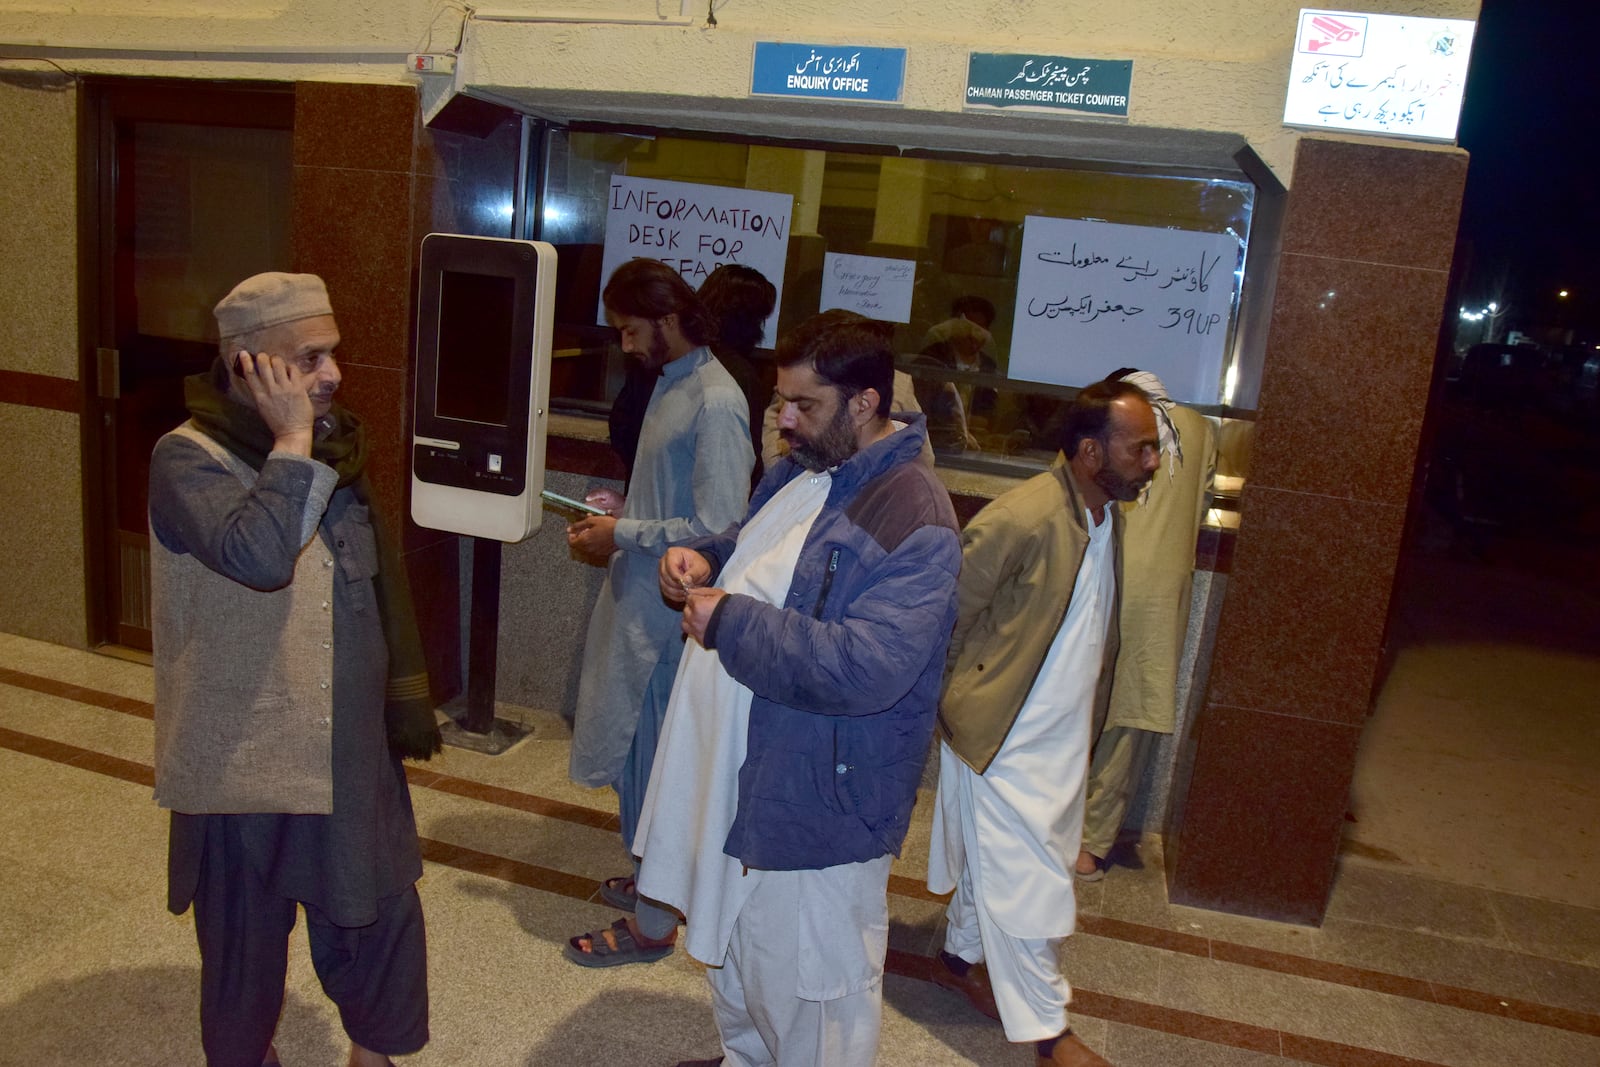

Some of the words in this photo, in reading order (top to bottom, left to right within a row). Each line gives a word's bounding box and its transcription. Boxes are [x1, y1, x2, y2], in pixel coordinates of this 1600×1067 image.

[795, 49, 823, 74] آفس
[1007, 59, 1034, 84] گھر
[1025, 61, 1053, 82] ٹکٹ
[1302, 60, 1330, 83] آنکھ
[787, 74, 831, 90] ENQUIRY
[832, 77, 869, 92] OFFICE
[1065, 66, 1091, 87] چمن
[1329, 62, 1349, 88] کی
[1346, 64, 1407, 92] کیمرے
[967, 86, 1003, 99] CHAMAN
[1003, 88, 1053, 102] PASSENGER
[1055, 91, 1084, 104] TICKET
[1085, 94, 1127, 106] COUNTER
[1318, 105, 1341, 122] ہے
[1344, 103, 1371, 120] رہی
[1373, 99, 1396, 124] دیکھ
[611, 184, 785, 240] INFORMATION
[629, 223, 681, 251] DESK
[698, 234, 743, 262] FOR
[1037, 242, 1109, 269] معلومات
[1115, 256, 1159, 282] برائے
[1159, 250, 1221, 293] کاؤنٹر
[1079, 300, 1144, 323] جعفر
[1158, 307, 1221, 335] 39UP
